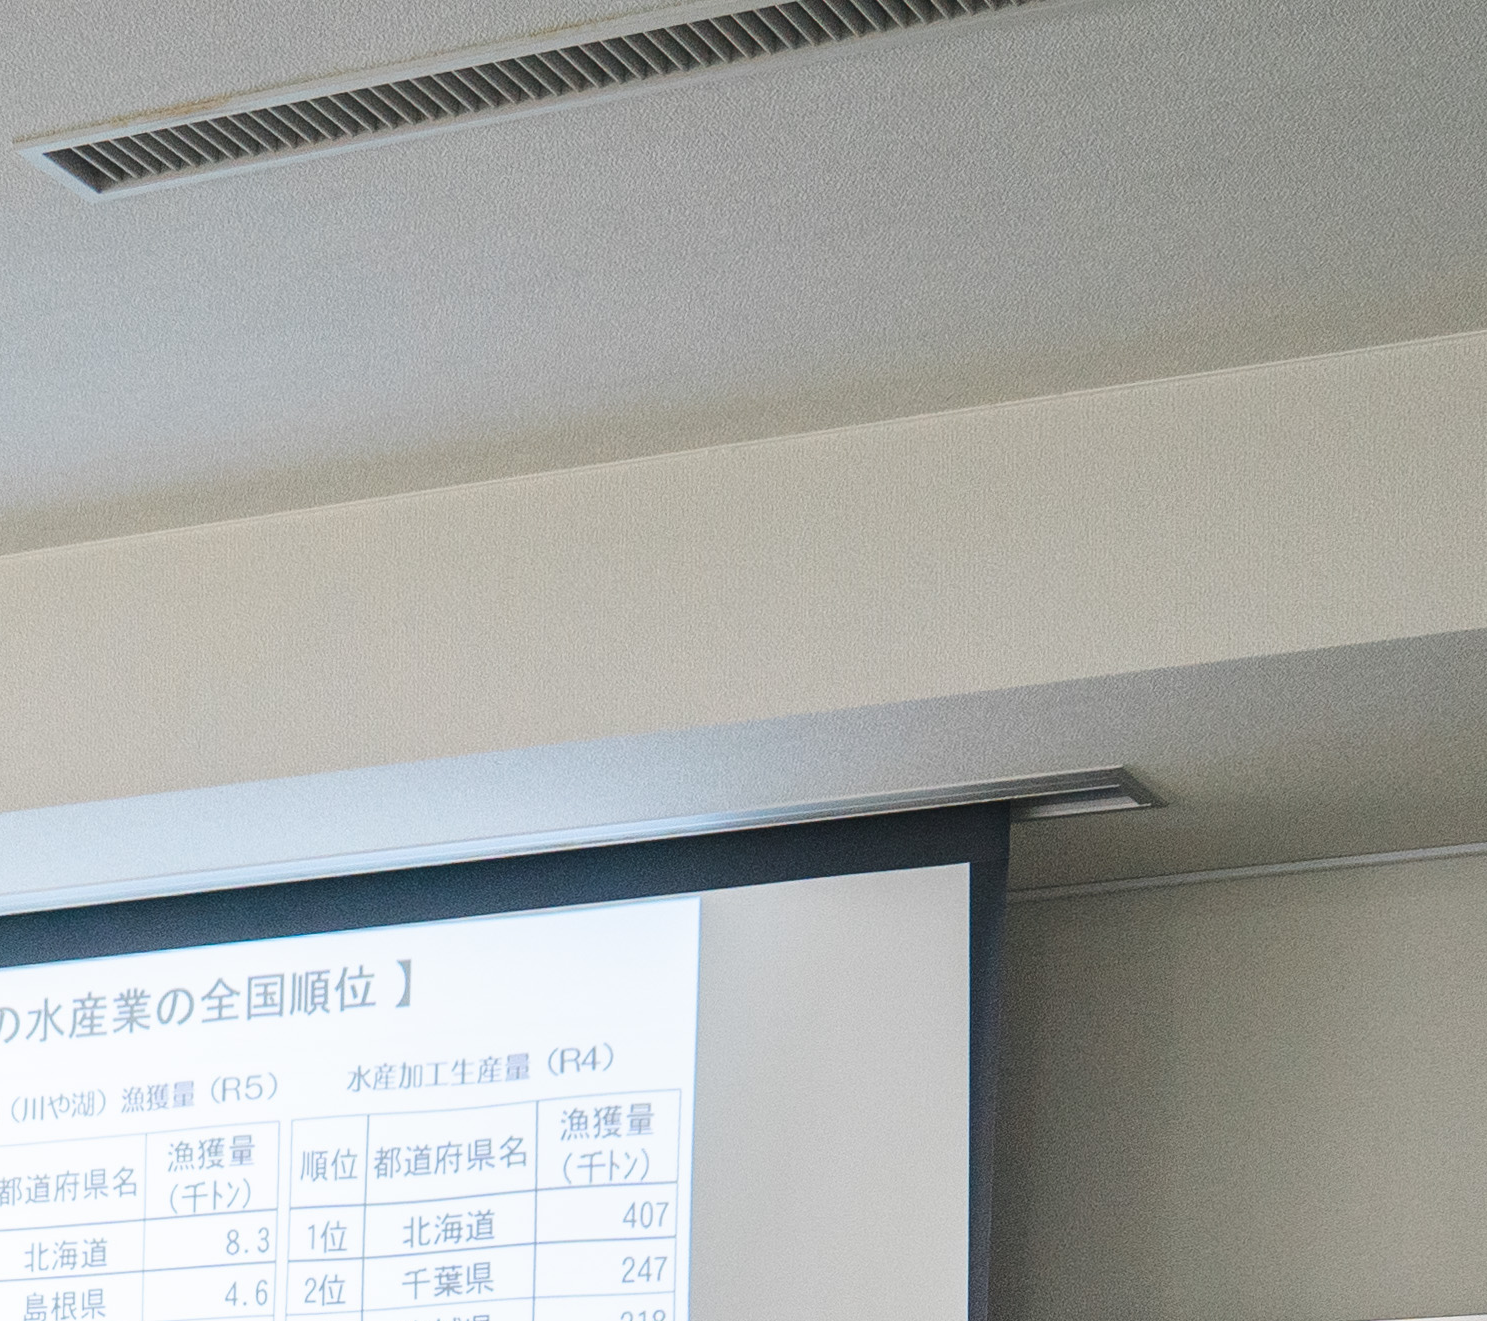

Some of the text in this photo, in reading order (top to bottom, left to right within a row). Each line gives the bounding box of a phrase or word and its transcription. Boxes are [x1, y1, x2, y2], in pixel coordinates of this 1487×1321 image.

[559, 1101, 655, 1143] 漁獲量
[166, 1133, 256, 1174] 漁獲量
[298, 1134, 528, 1184] 順位 都道府県名
[23, 1236, 109, 1274] 北海道
[224, 1225, 271, 1257] 8.3
[307, 1199, 670, 1255] 1位 北海道 407
[223, 1278, 270, 1308] 4.6
[302, 1254, 669, 1308] 2位 千葉県 247
